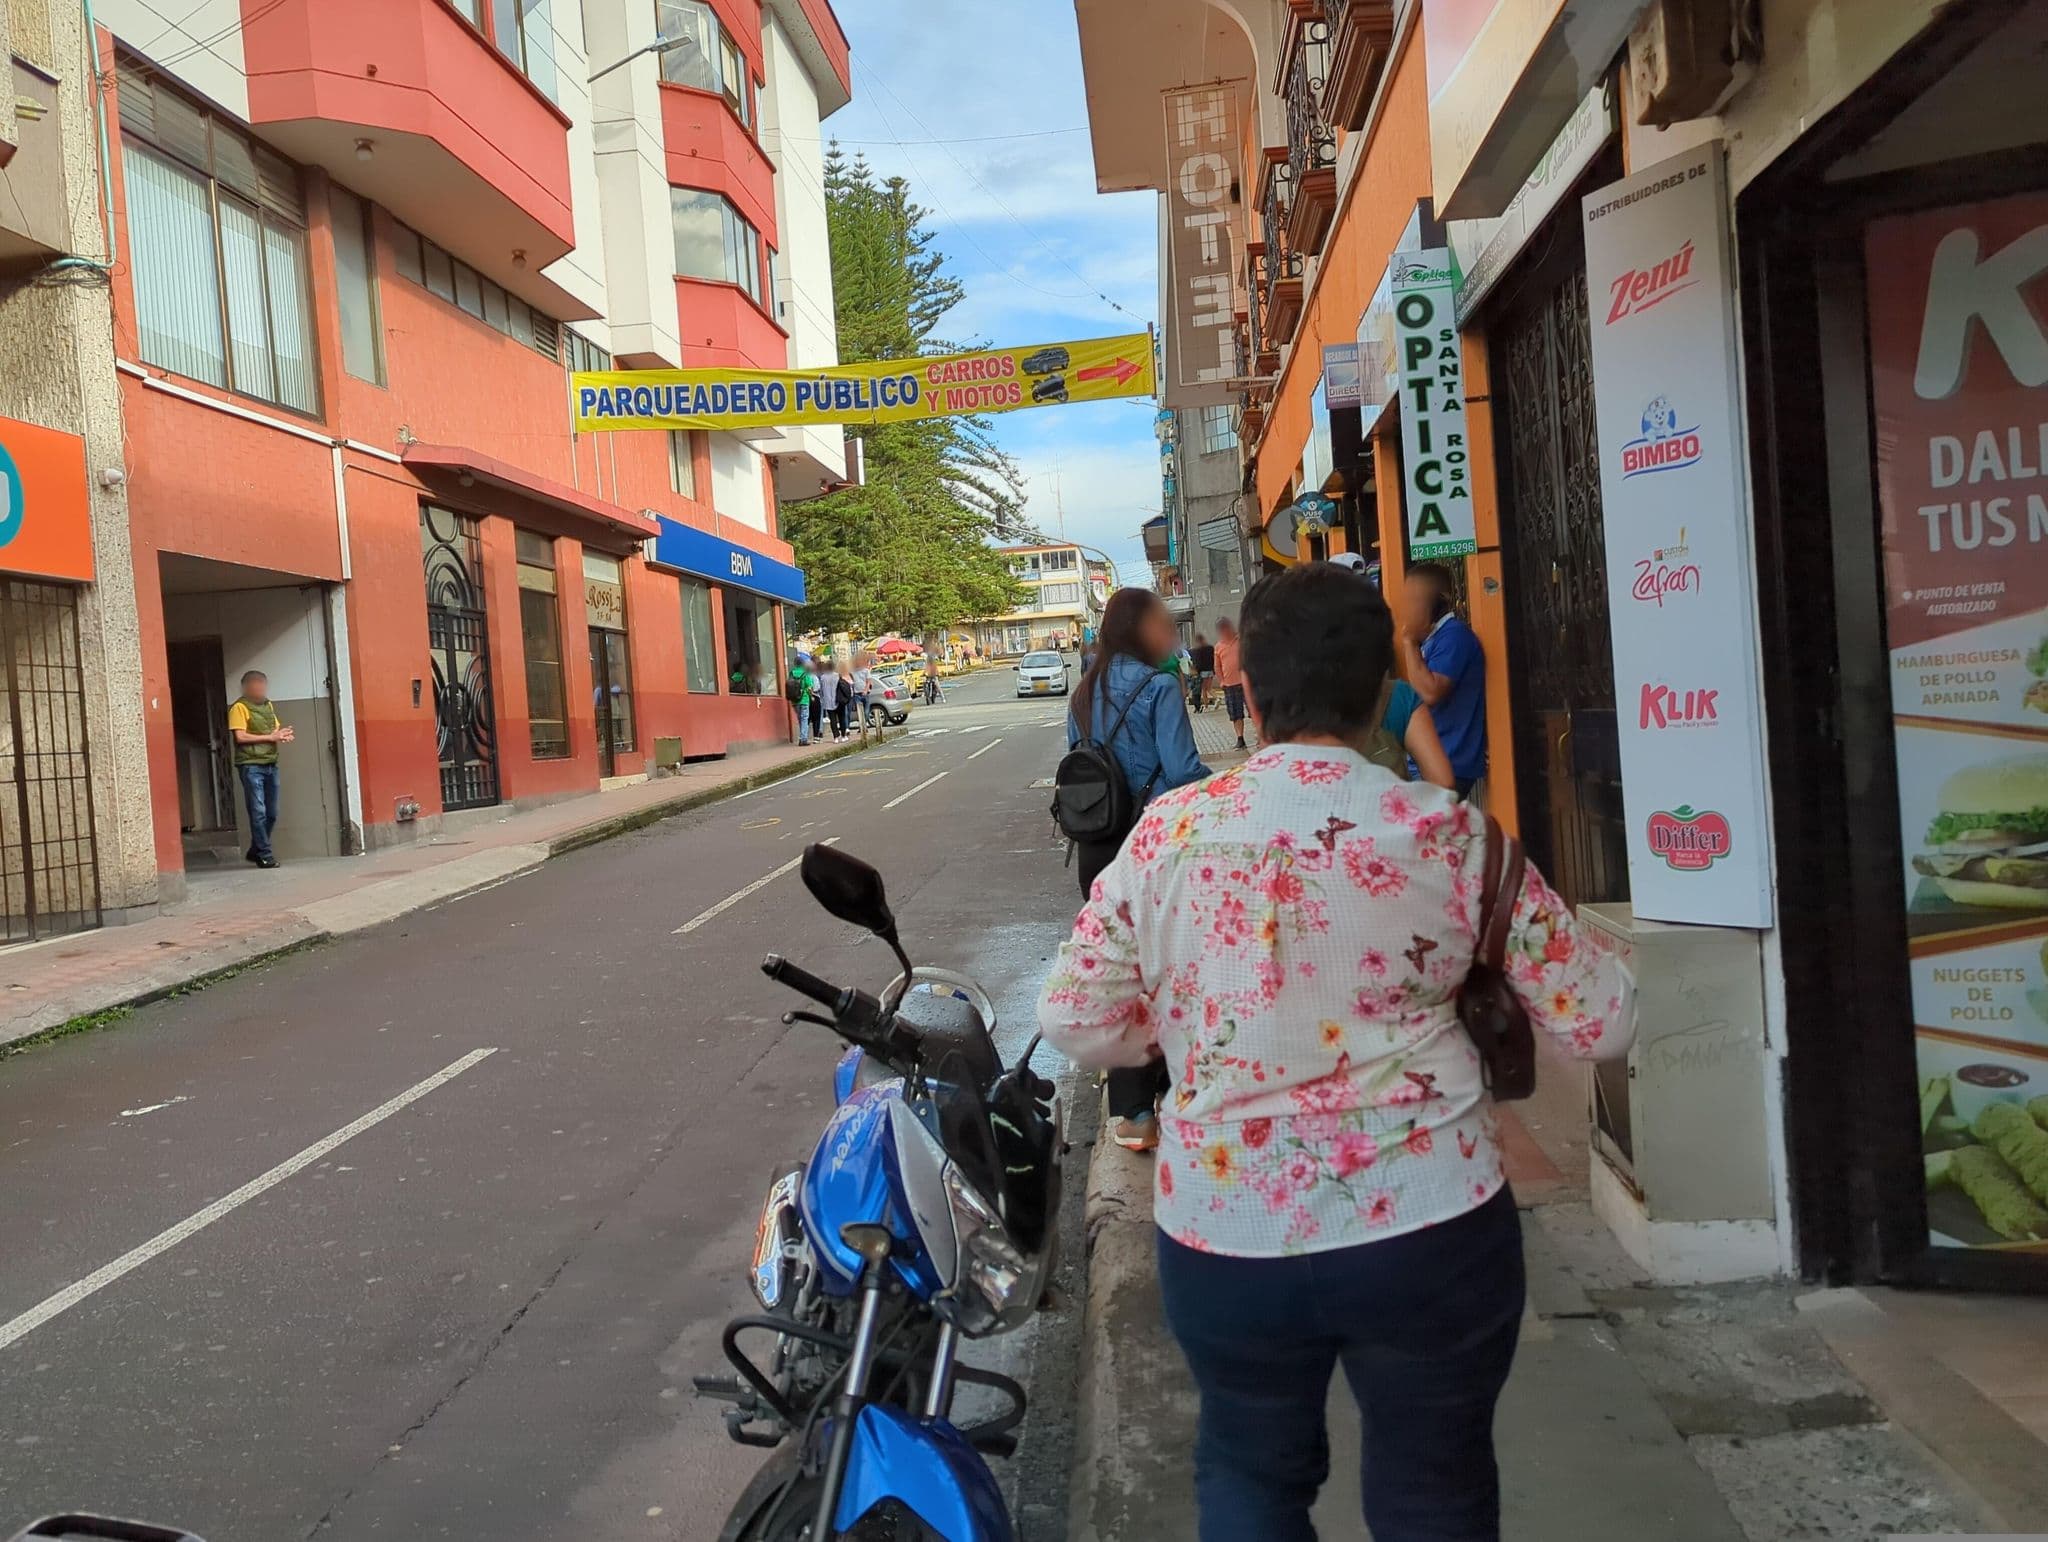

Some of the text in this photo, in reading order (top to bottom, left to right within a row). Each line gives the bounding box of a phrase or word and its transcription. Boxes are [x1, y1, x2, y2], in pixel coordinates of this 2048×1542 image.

[1588, 163, 1706, 221] DISTRIBUIDORES DE
[1606, 239, 1696, 326] Zenú
[927, 355, 1015, 385] CARROS
[580, 374, 918, 417] PARQUEADERO PÚBLICO
[925, 382, 1022, 412] Y MOTOS
[1396, 293, 1451, 538] OPTICA
[1439, 329, 1468, 499] SANTA ROSA
[1622, 436, 1702, 473] BIMBO
[1917, 497, 2017, 552] TUS
[1412, 547, 1430, 558] 321
[1431, 544, 1449, 556] 344
[730, 552, 753, 577] BBVA
[1915, 582, 2006, 600] PUNTO DE VENTA
[1926, 600, 1997, 616] AUTORIZADO
[1896, 649, 2022, 669] HAMBURGUESA
[1920, 670, 1996, 687] DE POLLO
[1922, 690, 2000, 705] APANADA
[1653, 825, 1722, 851] Differ
[1933, 967, 2025, 983] NUGGETS
[1967, 987, 1993, 1002] DE
[1950, 1006, 2014, 1021] POLLO
